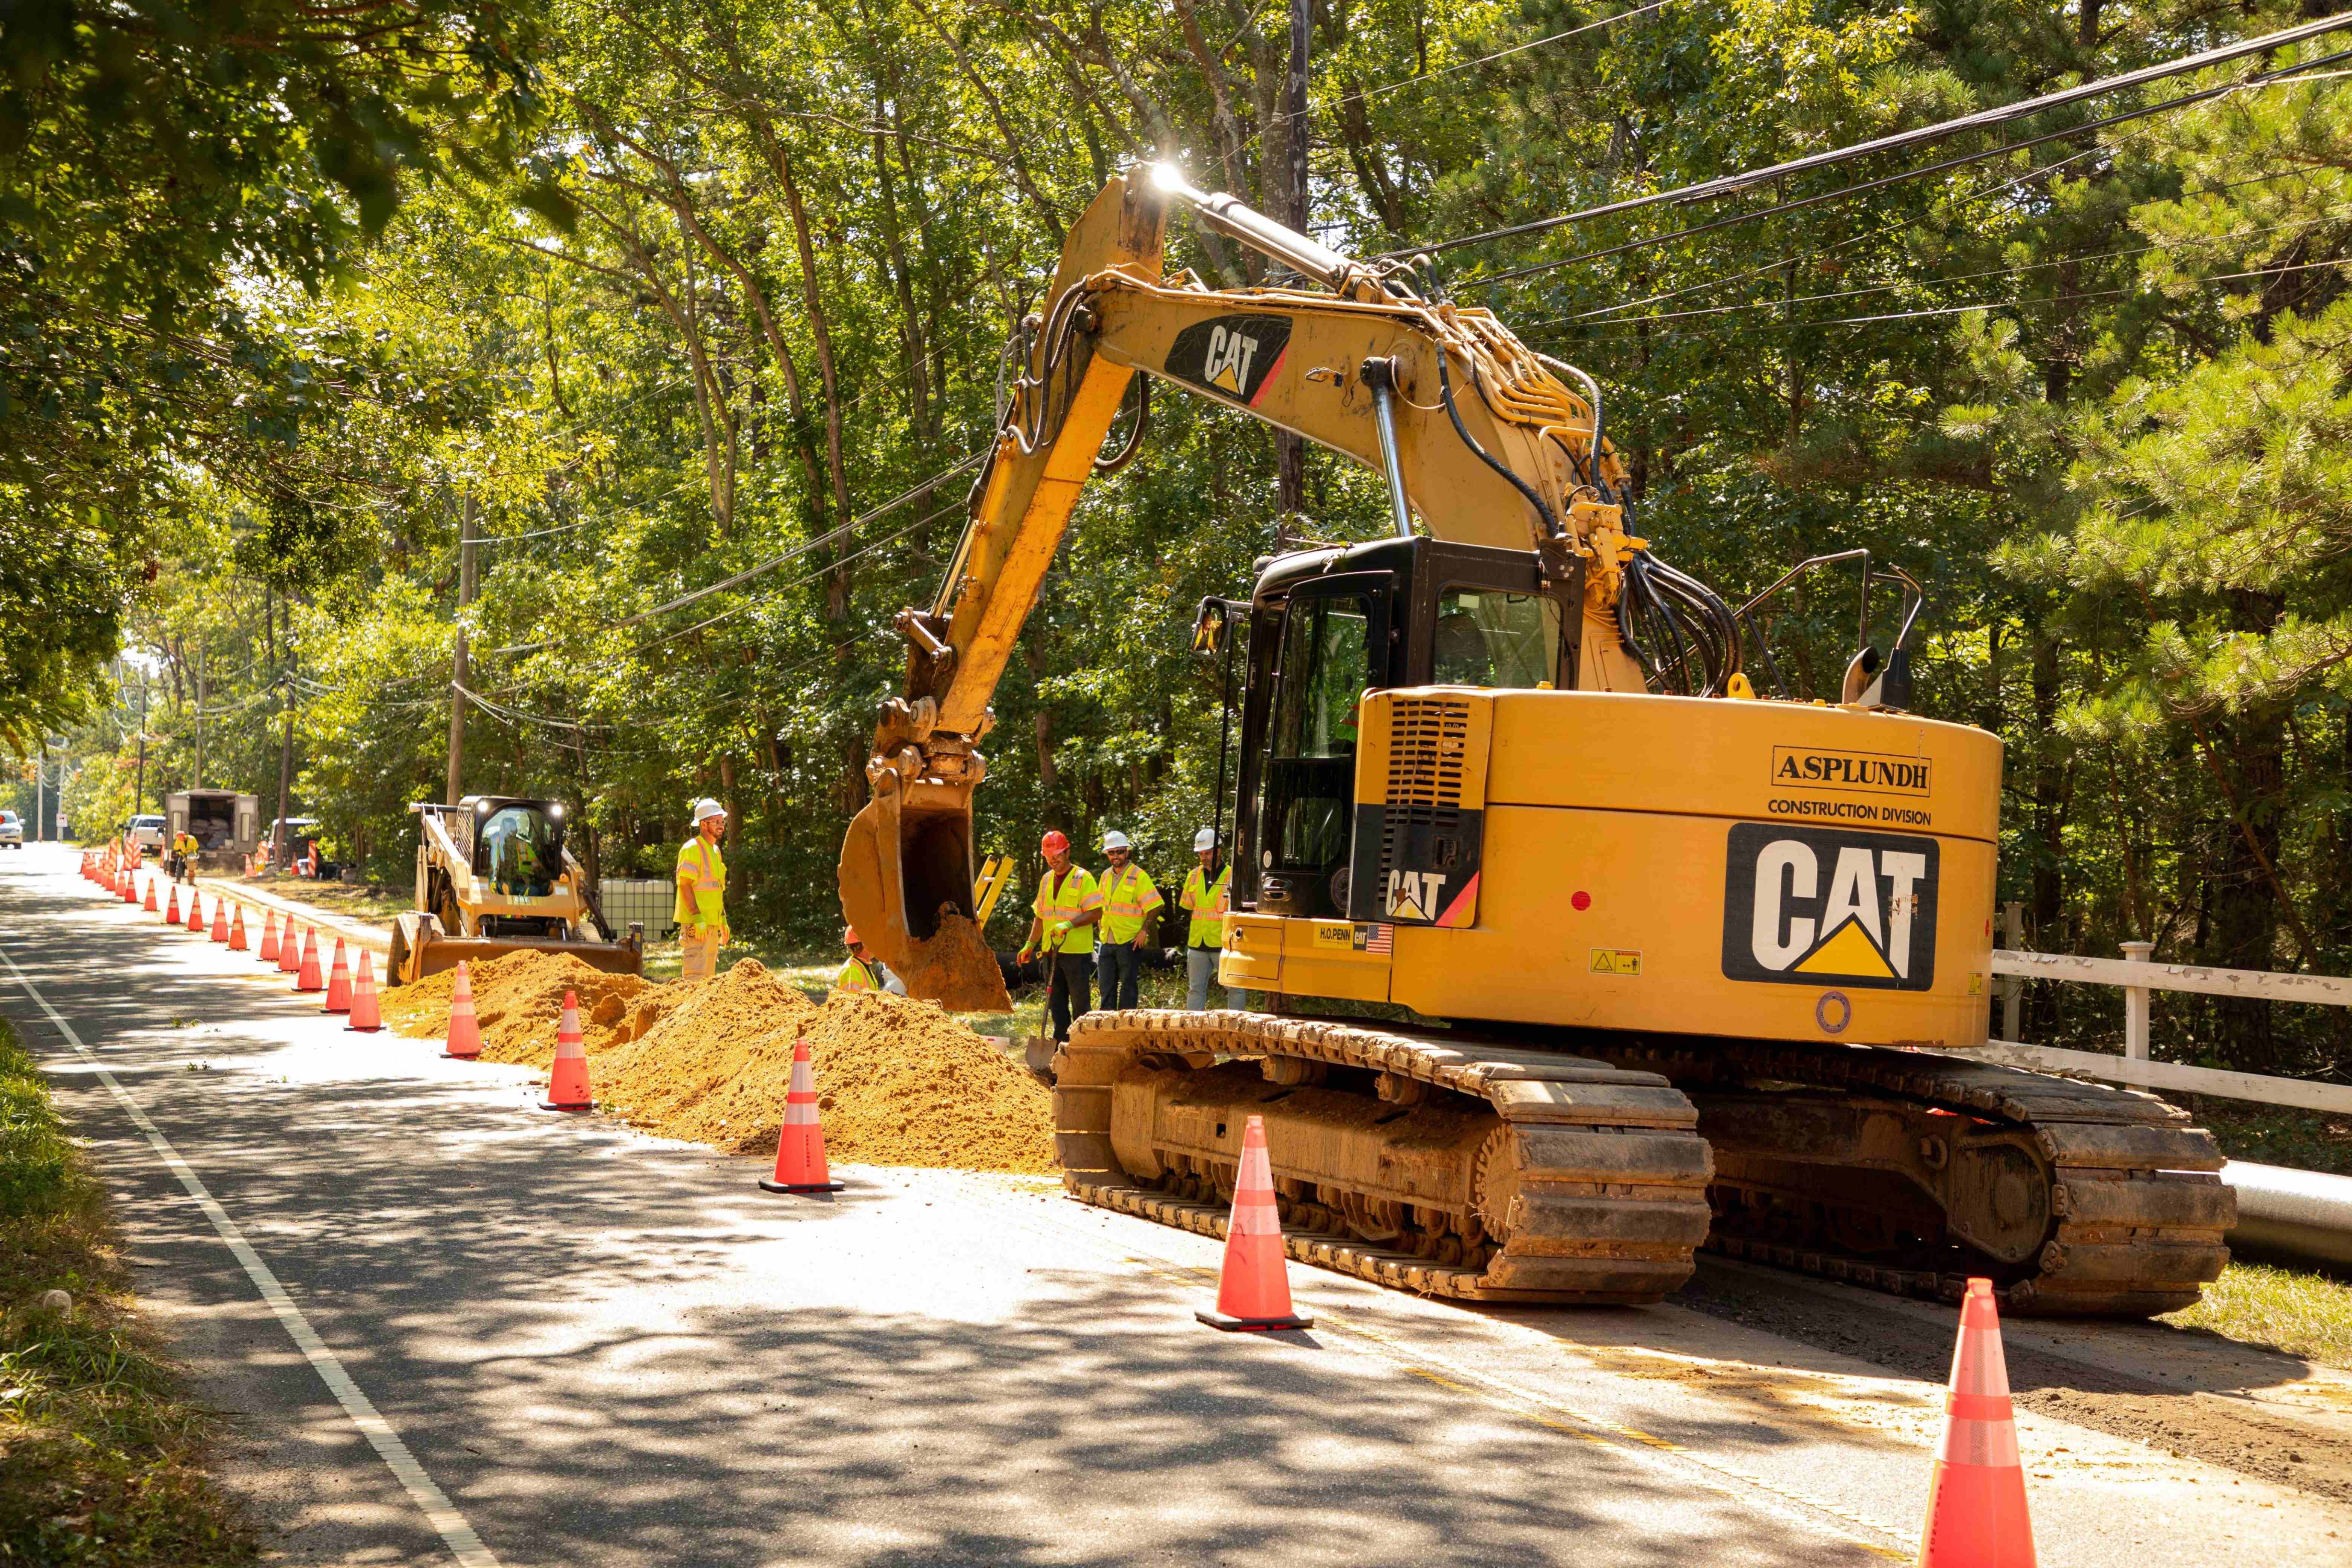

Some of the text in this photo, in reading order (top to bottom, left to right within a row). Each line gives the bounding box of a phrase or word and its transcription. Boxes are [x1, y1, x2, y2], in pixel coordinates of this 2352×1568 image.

[1205, 325, 1258, 395] CAT
[1778, 756, 1928, 789] ASPLUNDH
[1768, 799, 1931, 825] CONSTRUCTION DIVISION
[1386, 870, 1446, 920] CAT
[1752, 840, 1926, 979] CAT
[1354, 931, 1367, 944] CAT
